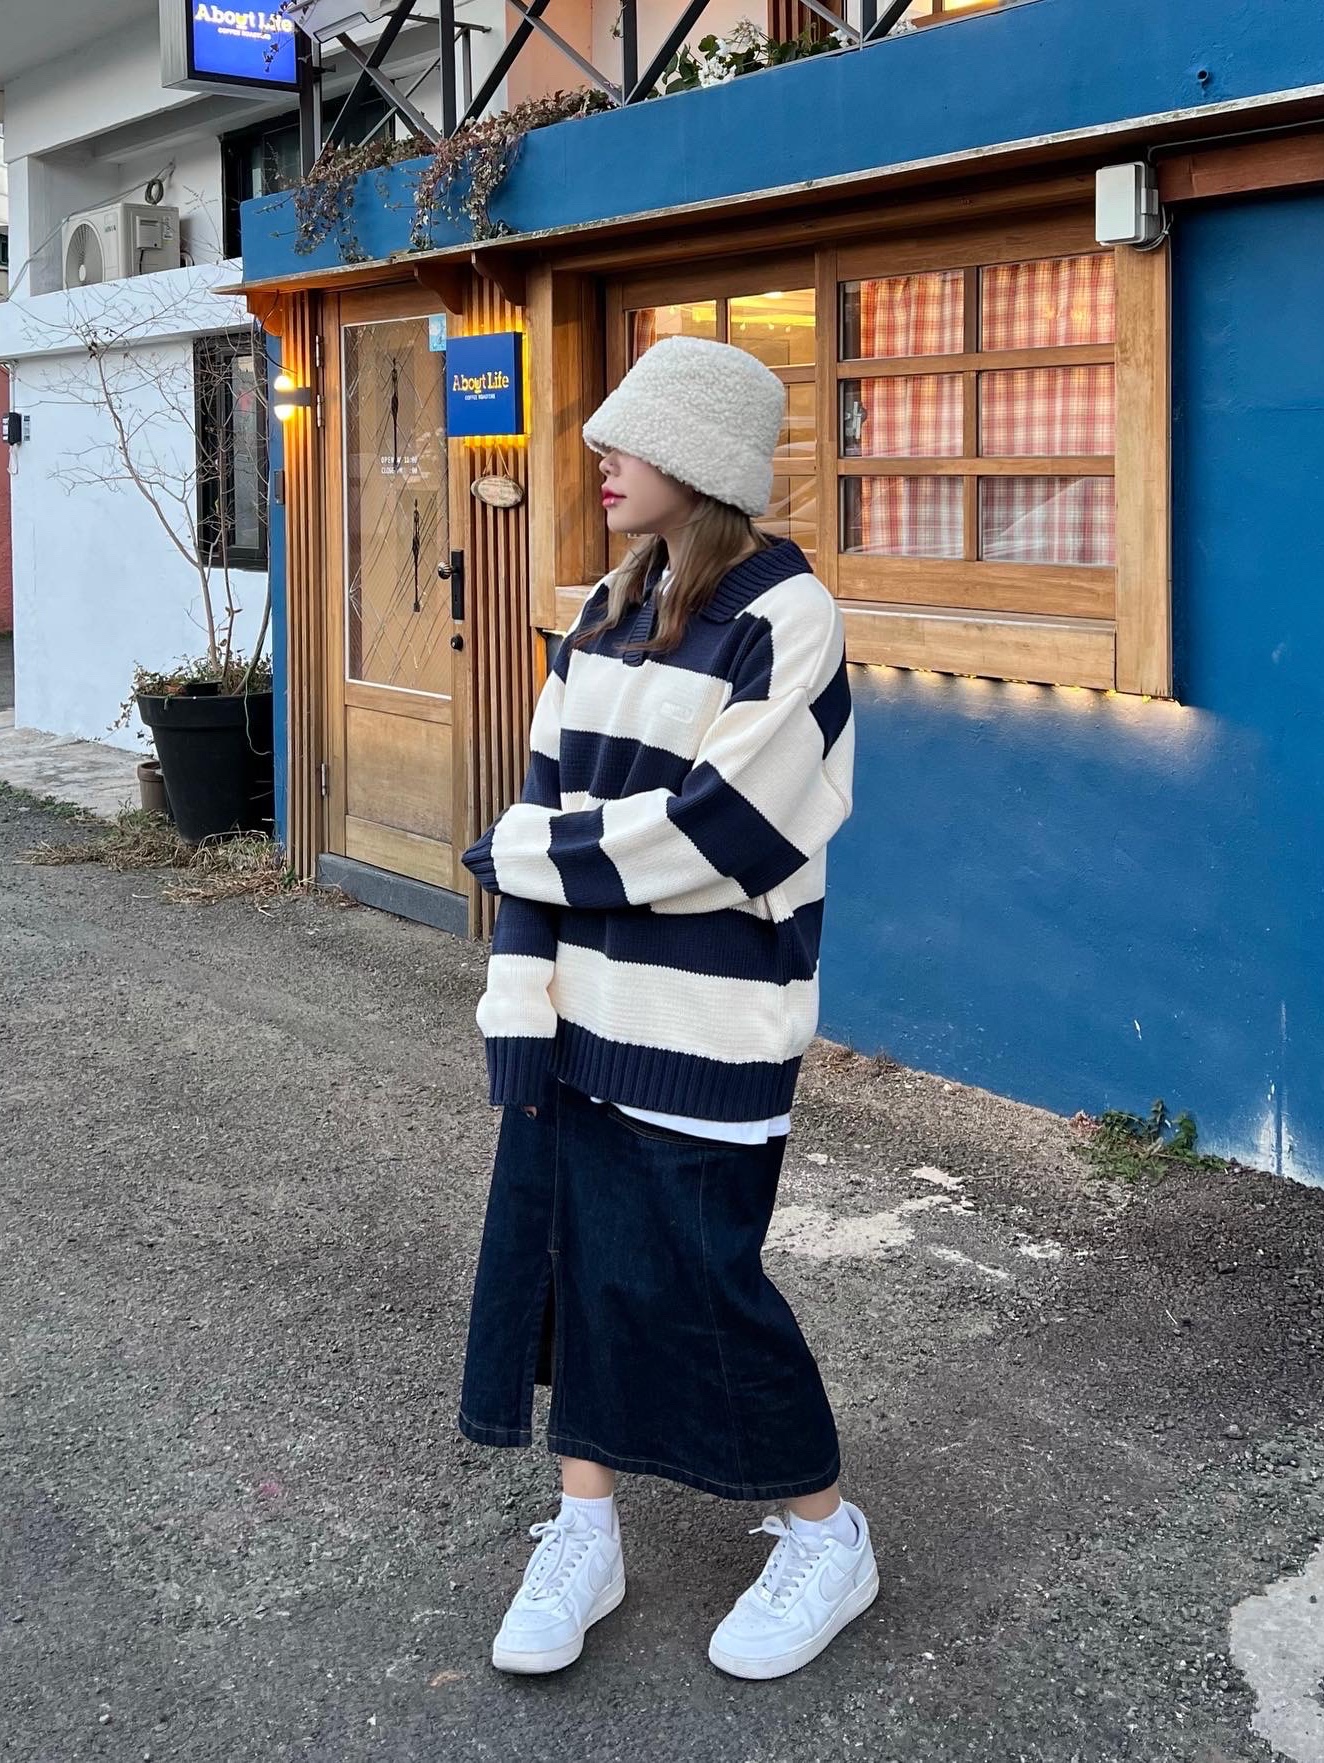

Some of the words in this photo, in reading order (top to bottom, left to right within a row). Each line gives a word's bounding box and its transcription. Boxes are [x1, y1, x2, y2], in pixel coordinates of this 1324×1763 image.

[195, 3, 256, 28] About
[453, 374, 486, 394] About
[487, 371, 509, 389] Life
[381, 456, 395, 464] OPEN
